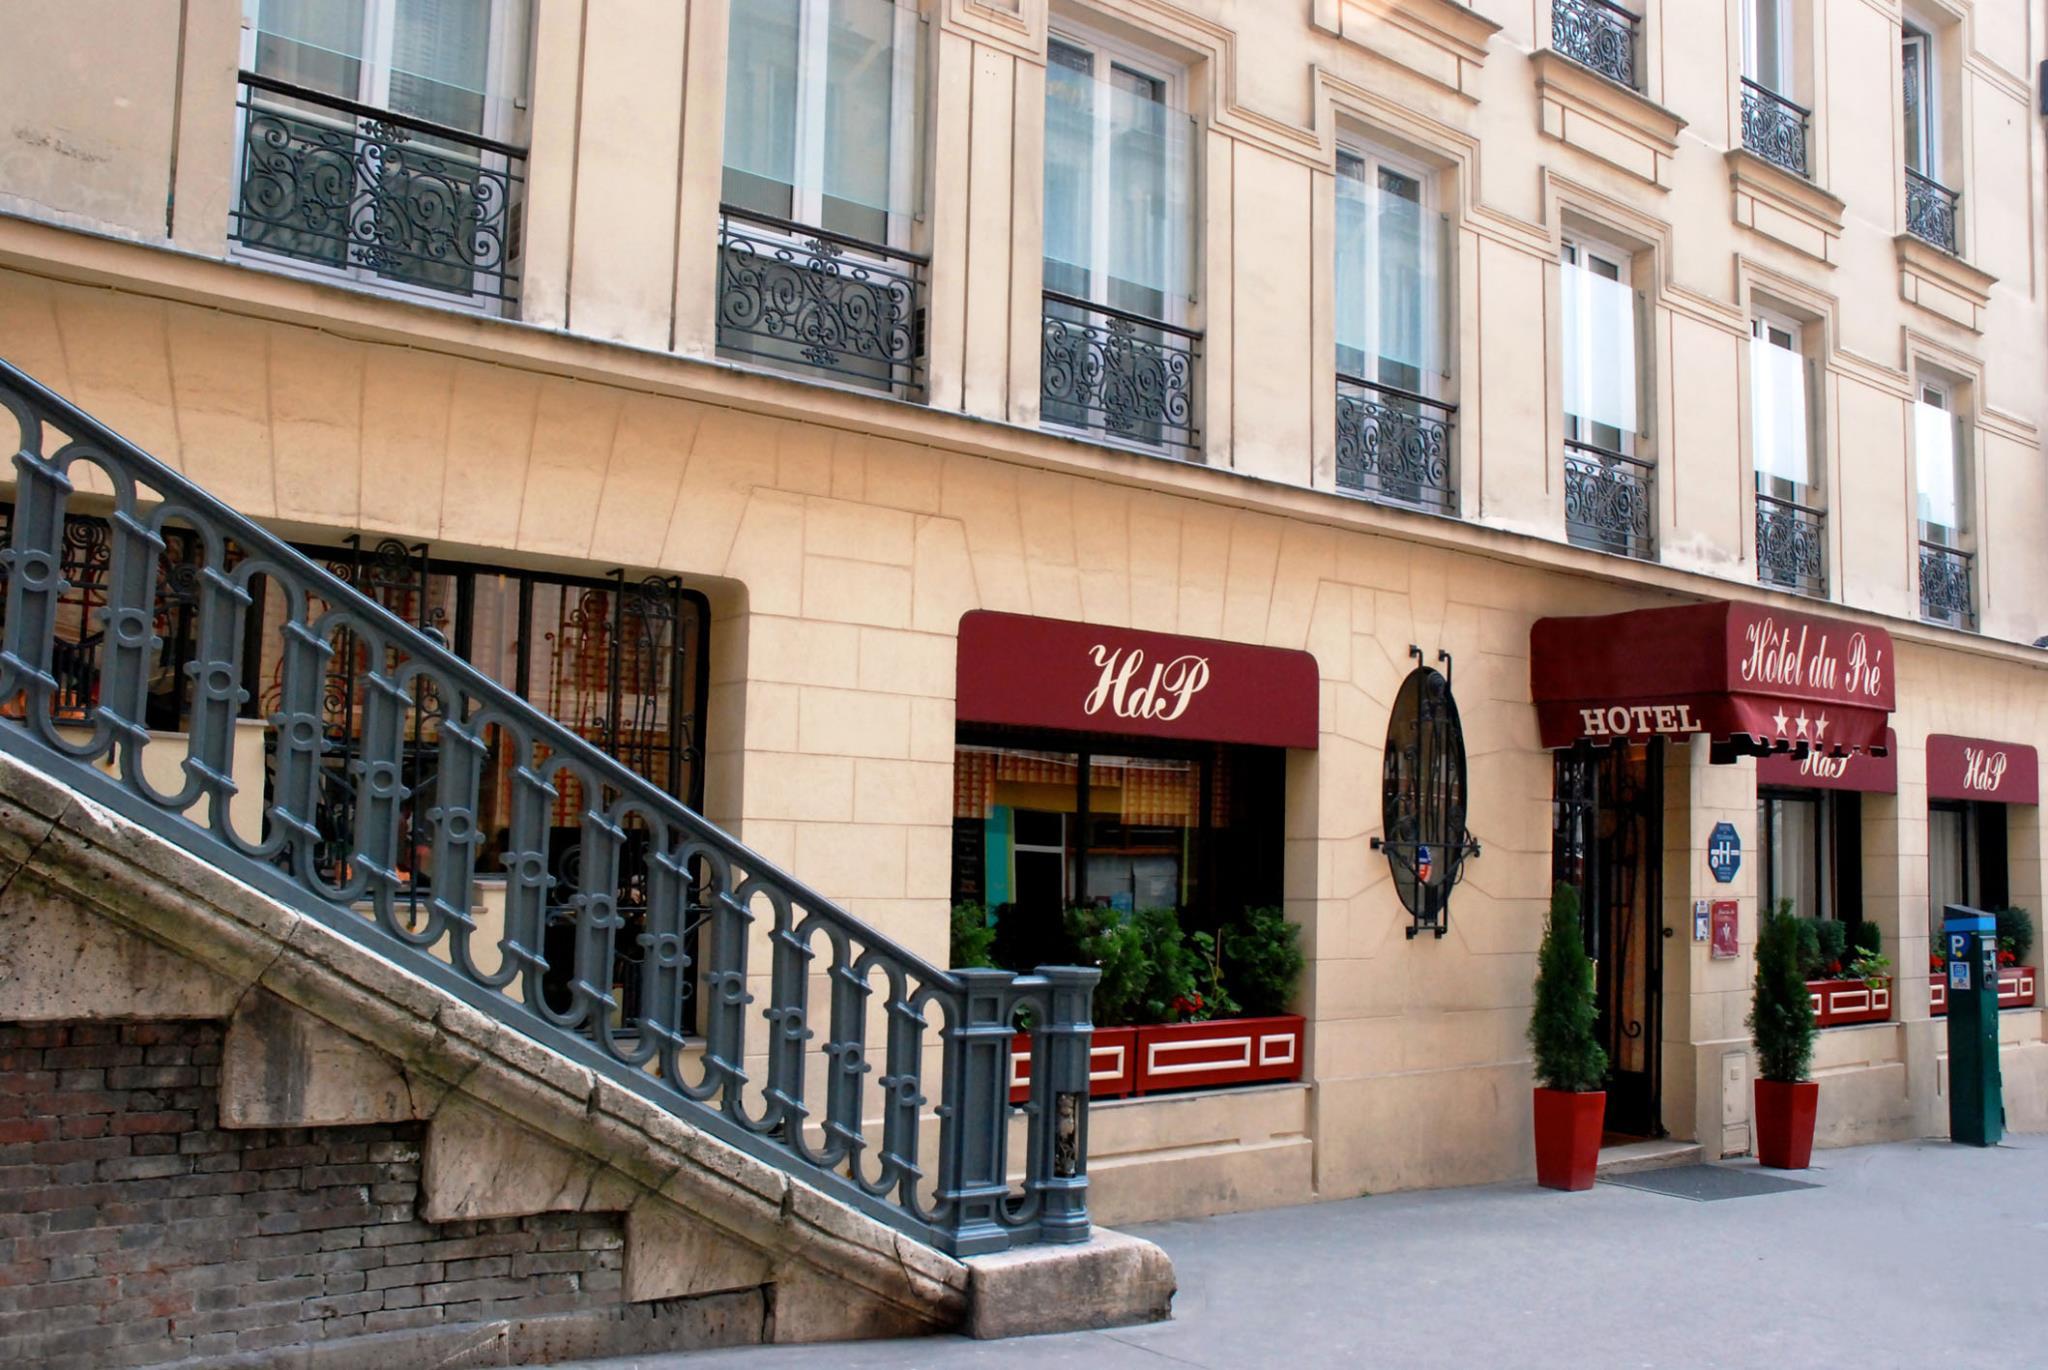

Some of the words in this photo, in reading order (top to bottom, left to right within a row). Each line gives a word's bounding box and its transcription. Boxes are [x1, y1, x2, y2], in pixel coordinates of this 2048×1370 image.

[1742, 617, 1807, 686] Hôtel
[1809, 635, 1837, 689] du
[1845, 632, 1882, 696] Pré
[1084, 644, 1209, 721] HdP
[1579, 705, 1702, 735] HOTEL
[1963, 747, 2007, 791] HdP
[1719, 841, 1730, 865] H
[1951, 935, 1965, 955] P
